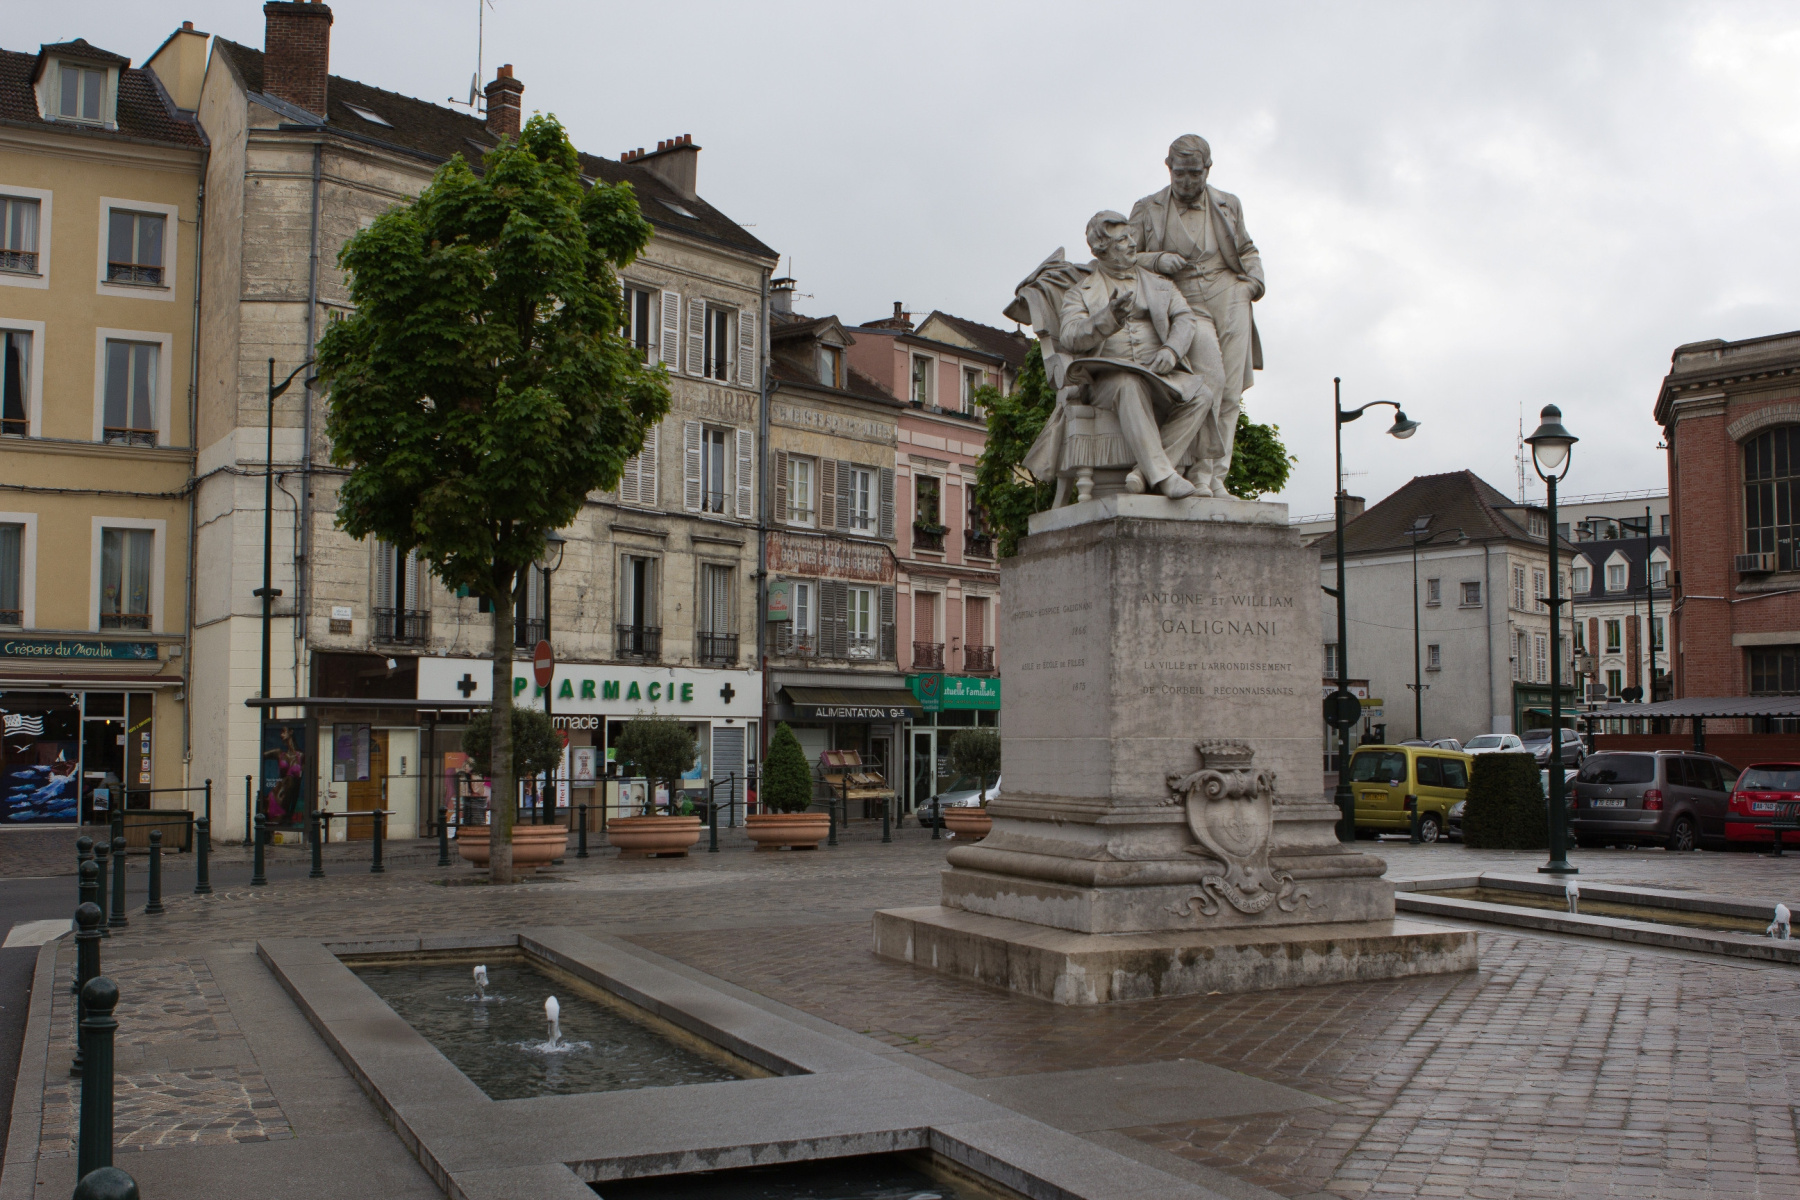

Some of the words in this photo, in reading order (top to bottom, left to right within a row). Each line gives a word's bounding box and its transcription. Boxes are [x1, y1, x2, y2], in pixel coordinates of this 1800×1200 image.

[781, 548, 817, 565] GRAINES
[819, 554, 829, 565] EN
[830, 555, 850, 569] TOUS
[852, 557, 881, 571] GENRES
[1215, 571, 1222, 580] A
[1142, 593, 1203, 605] ANTOINE
[1211, 597, 1223, 606] ET
[1231, 595, 1293, 608] WILLIAM
[1162, 619, 1276, 636] GALIGNANI
[4, 642, 53, 656] Crêperie
[55, 641, 70, 656] du
[72, 643, 113, 657] Moulin
[1144, 661, 1155, 670] LA
[1158, 661, 1185, 670] VILLE
[1188, 663, 1198, 671] ET
[966, 687, 996, 697] Familiale
[1143, 686, 1155, 694] DE
[1213, 686, 1294, 695] RECONNAISSANTS
[816, 707, 885, 718] ALIMENTATION
[1223, 883, 1240, 905] BELLO
[1242, 893, 1273, 911] PACEQUE
